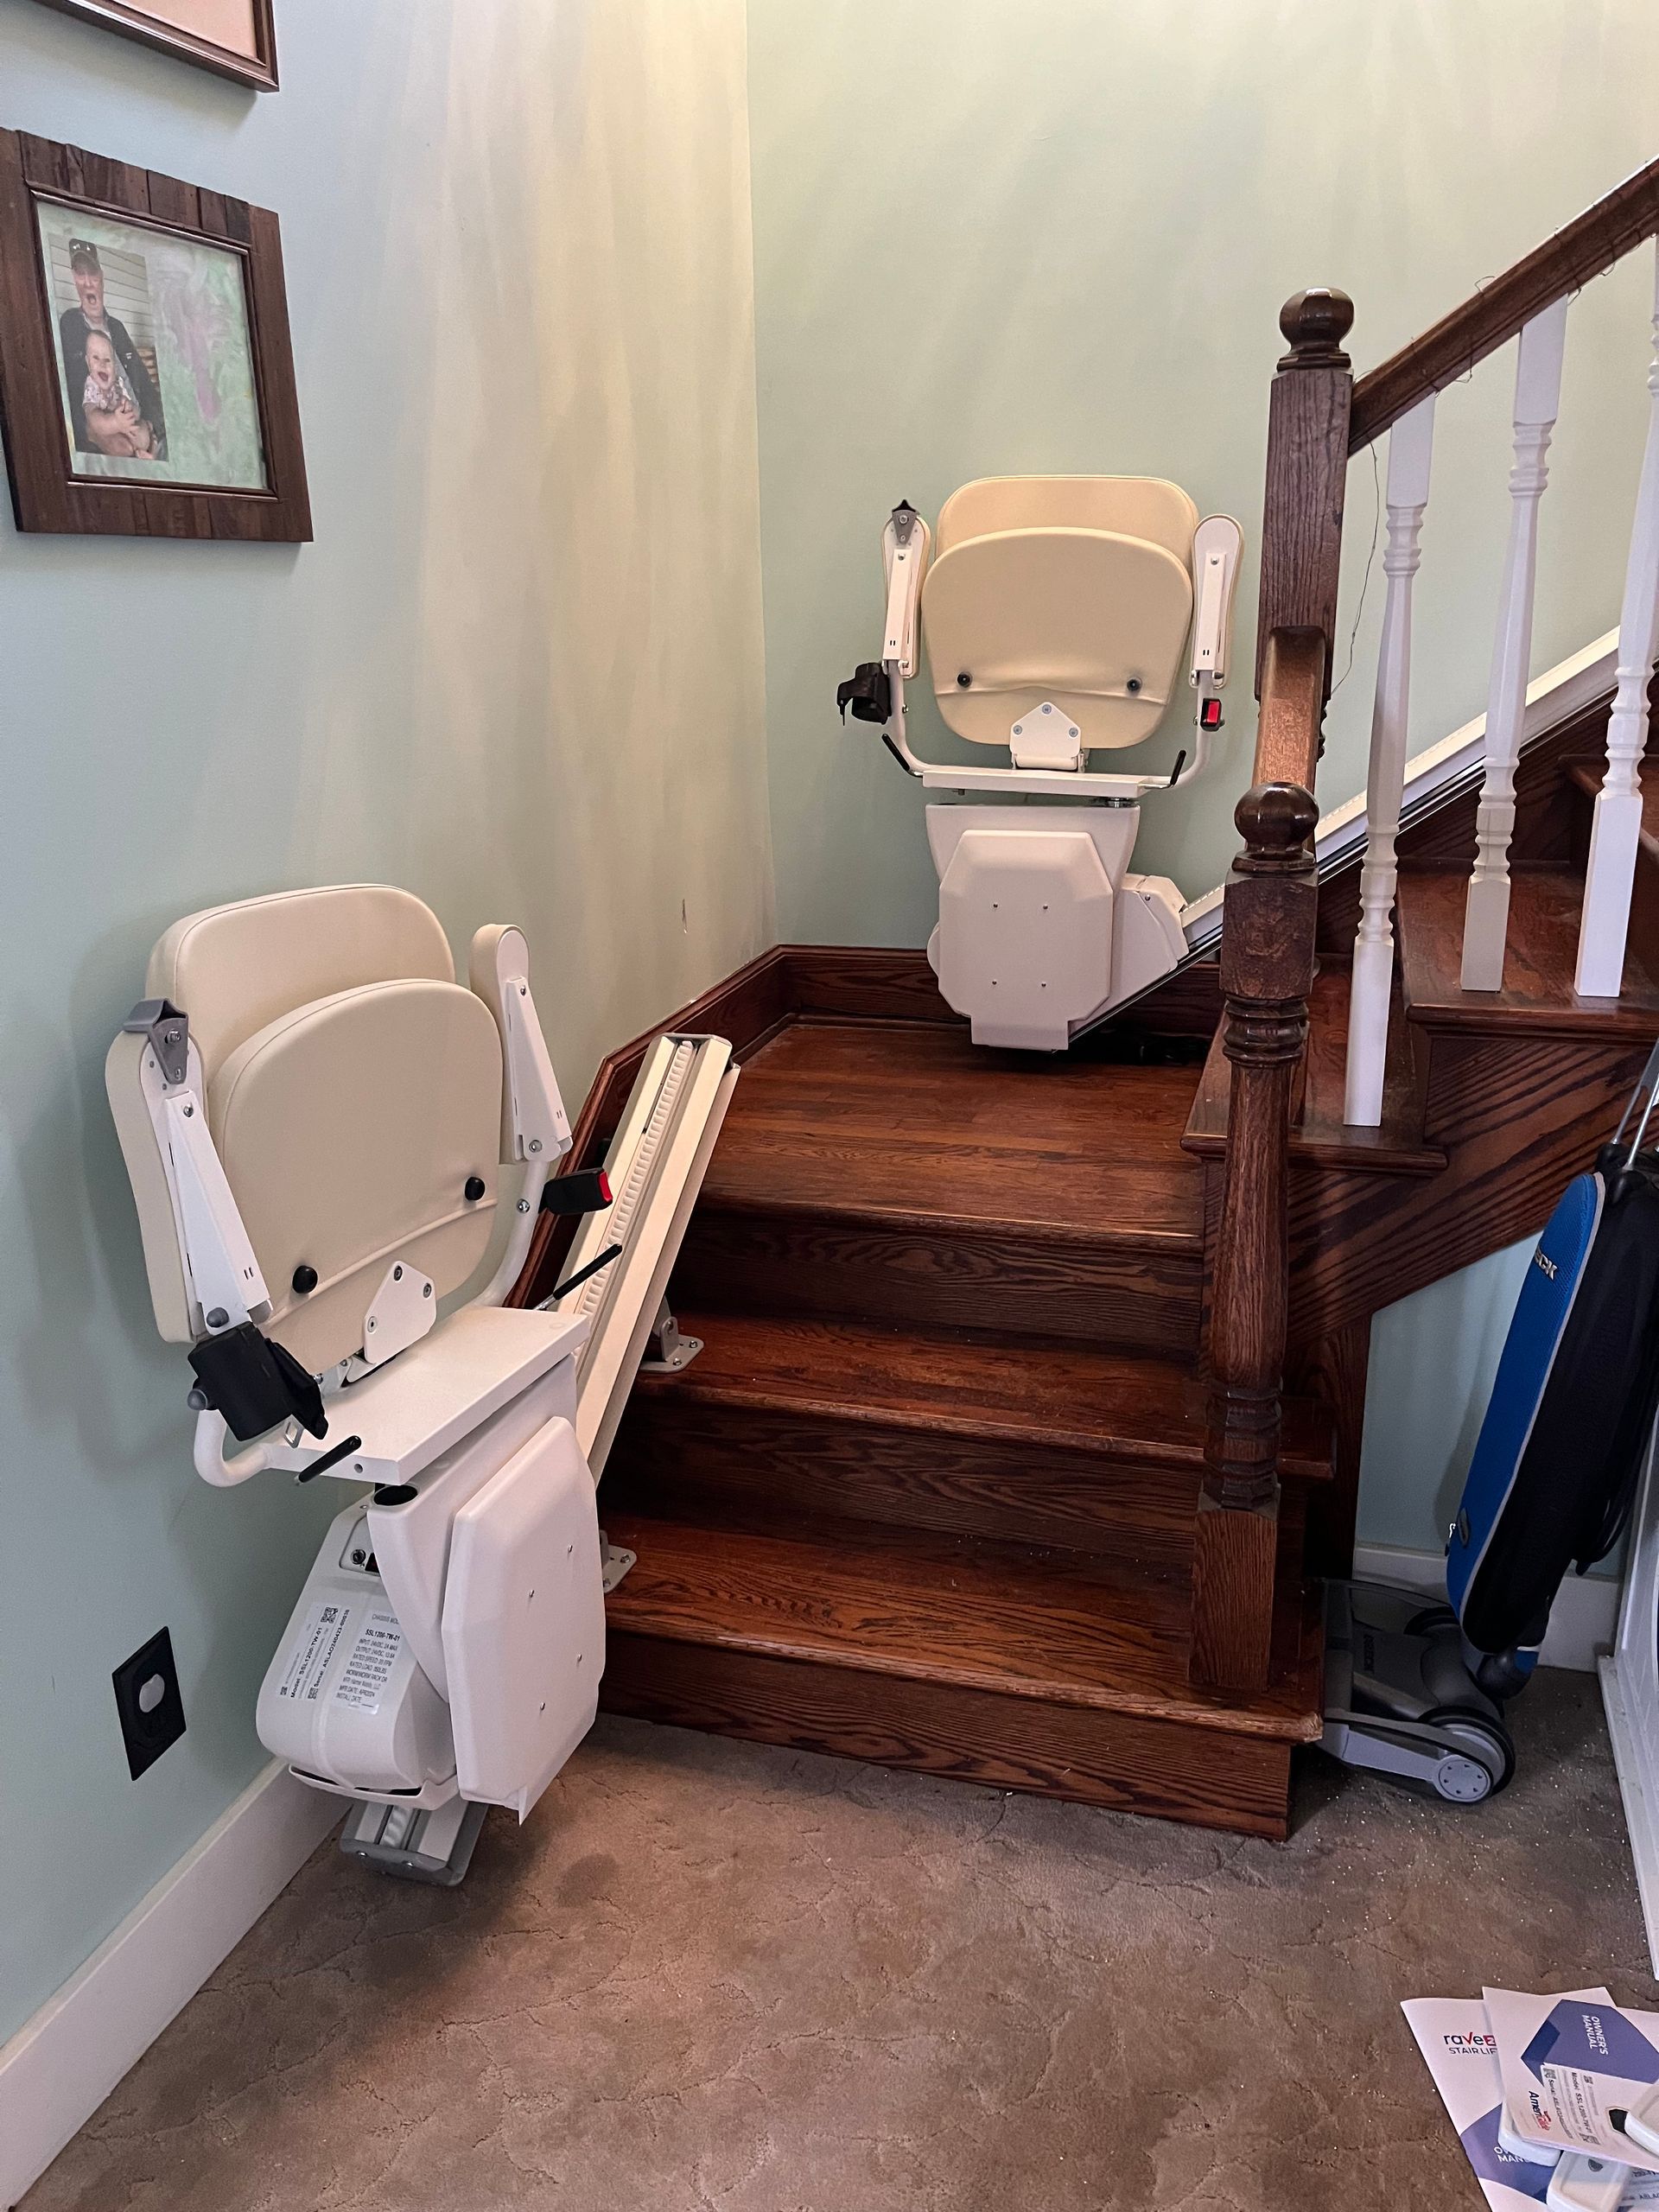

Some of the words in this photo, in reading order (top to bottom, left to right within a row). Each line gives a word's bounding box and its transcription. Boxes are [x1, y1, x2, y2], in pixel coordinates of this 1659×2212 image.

[1535, 1247, 1557, 1280] ECK
[1581, 2015, 1599, 2050] MANUAL
[1591, 2016, 1609, 2055] OWNER'S
